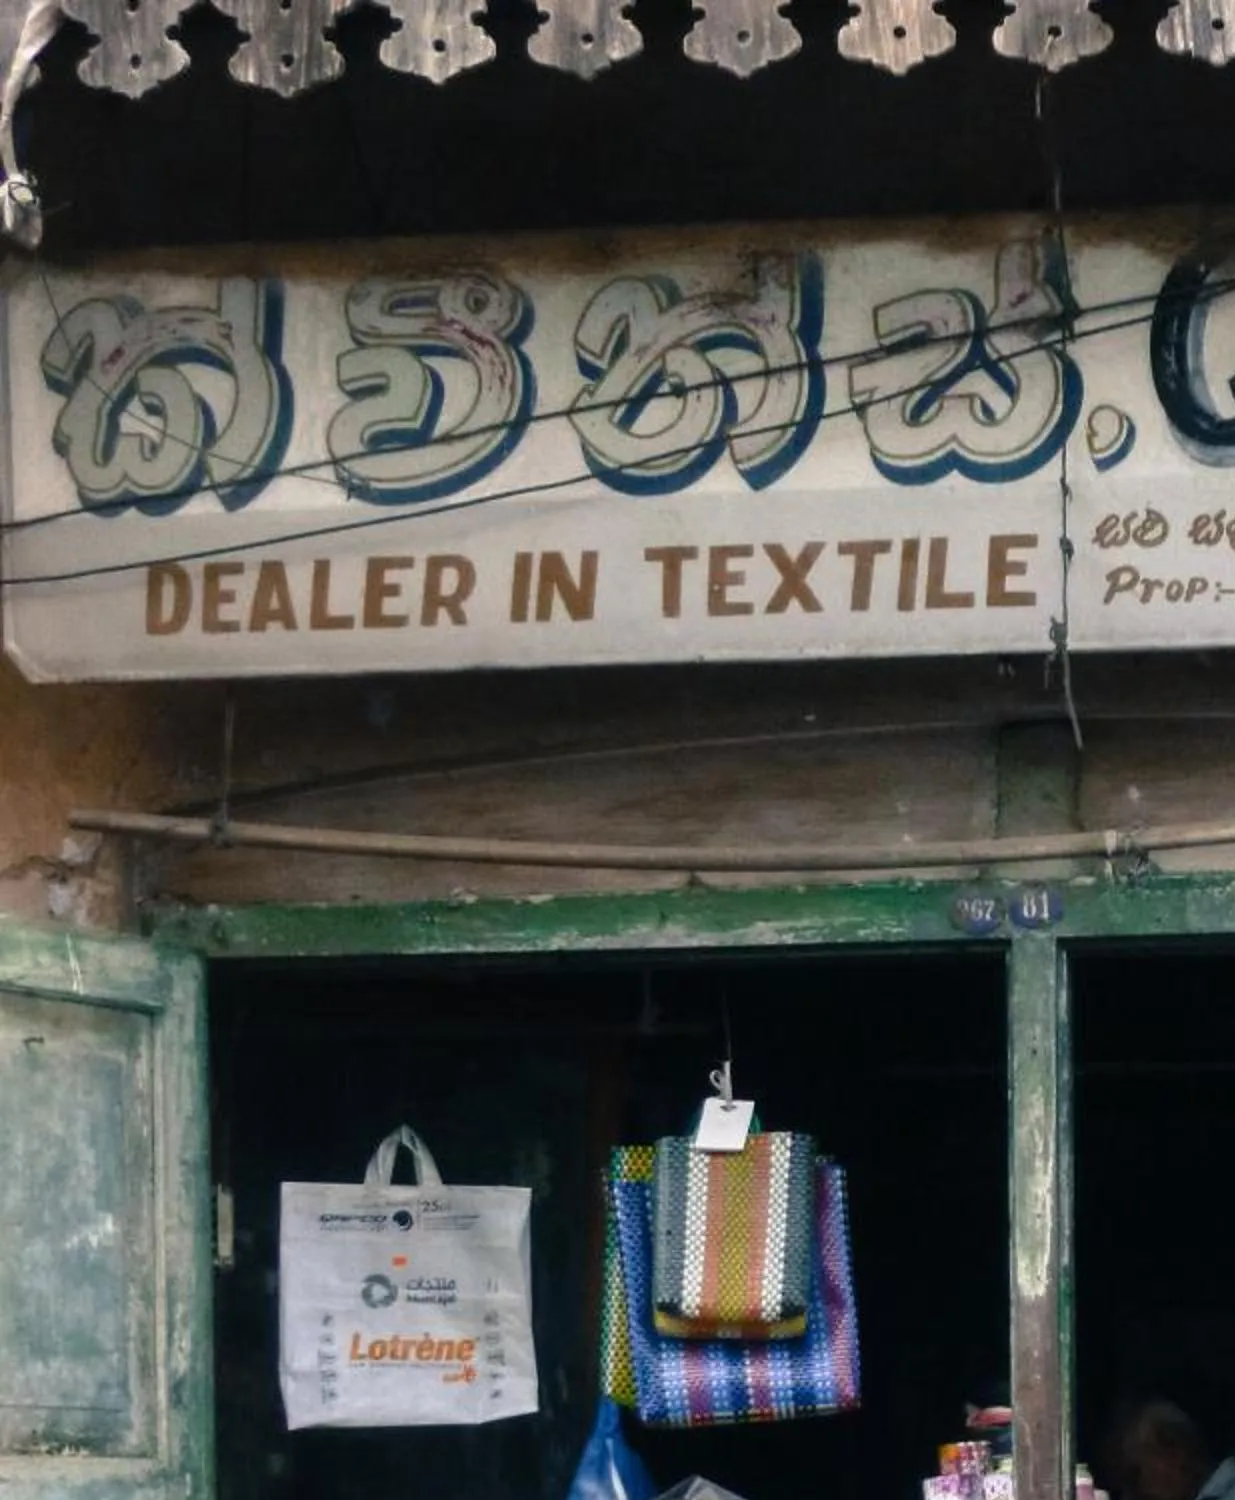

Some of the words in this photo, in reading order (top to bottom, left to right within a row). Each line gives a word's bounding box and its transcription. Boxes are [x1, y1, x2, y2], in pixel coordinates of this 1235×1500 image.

[144, 554, 476, 637] DEALER
[509, 550, 598, 623] IN
[644, 533, 1039, 619] TEXTILE
